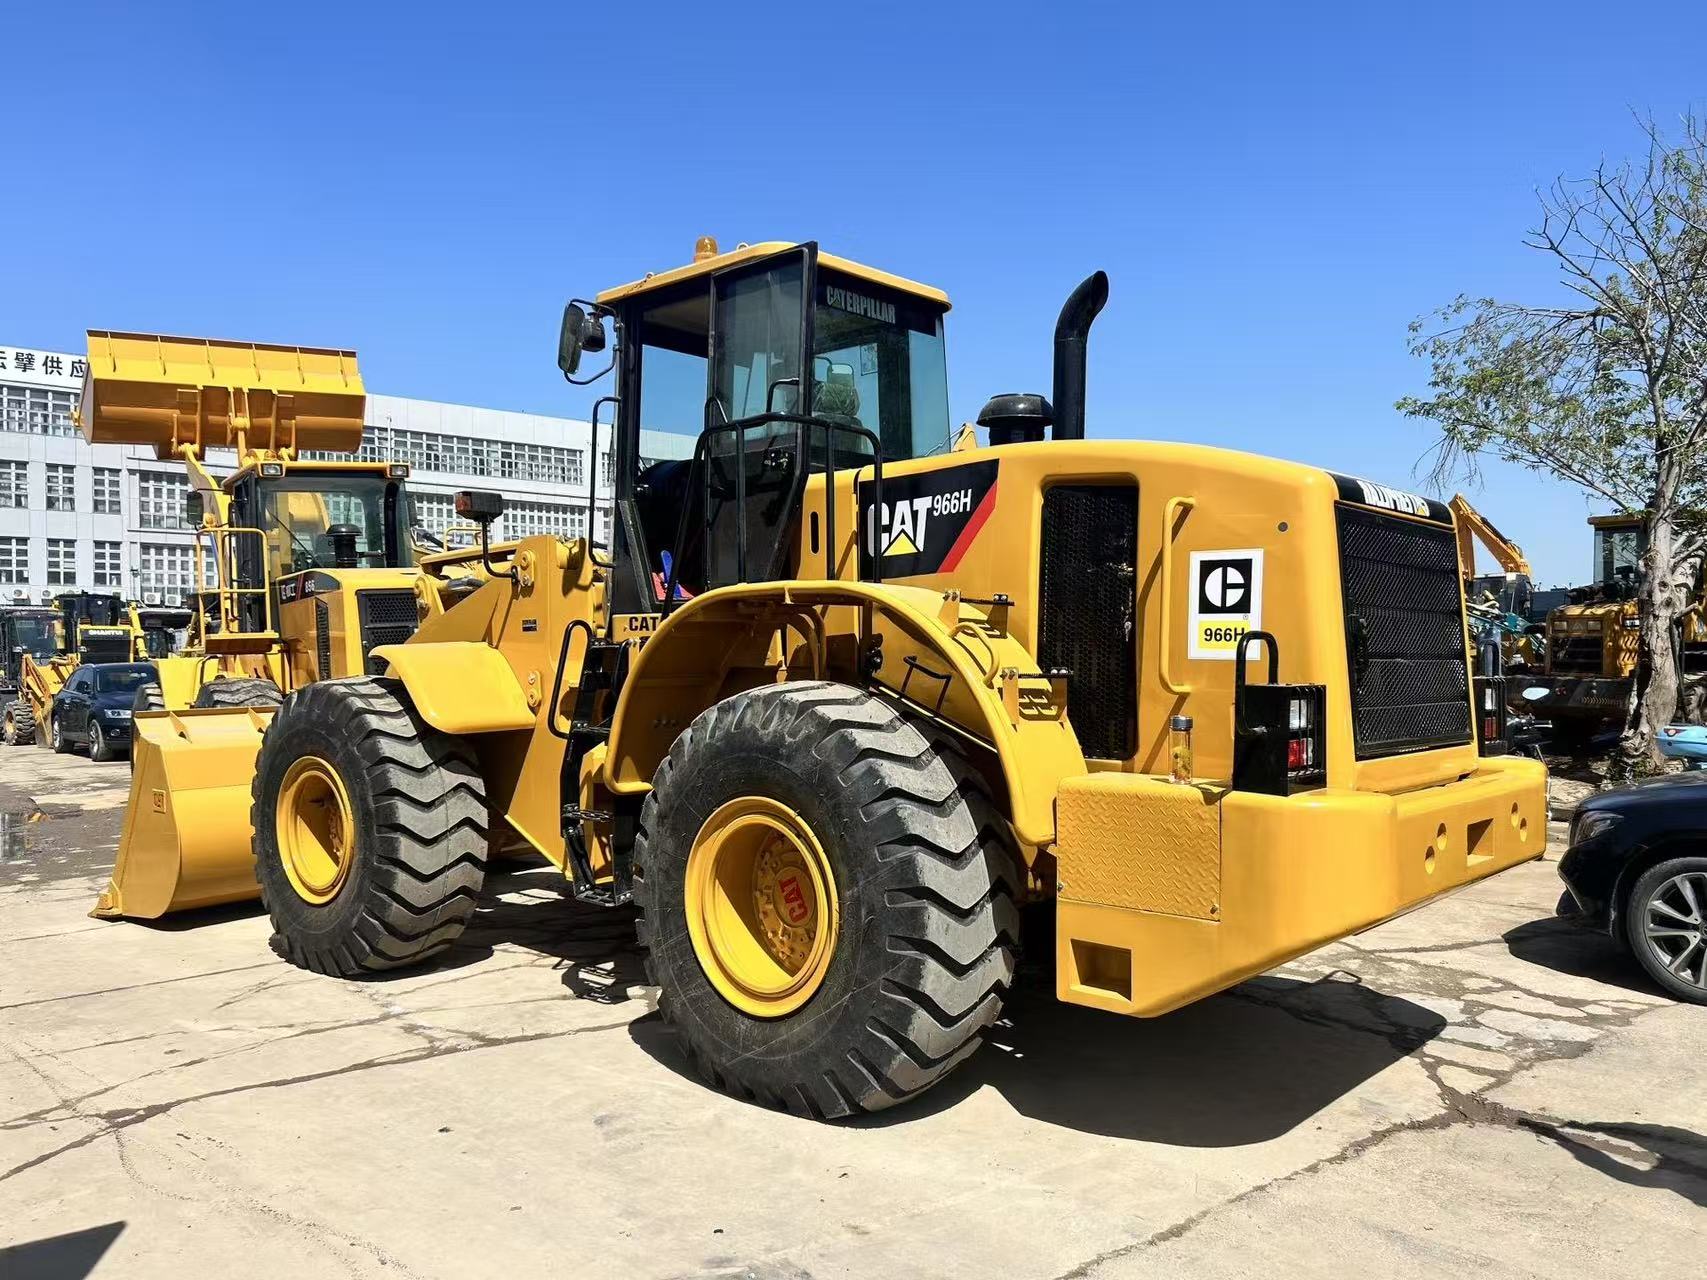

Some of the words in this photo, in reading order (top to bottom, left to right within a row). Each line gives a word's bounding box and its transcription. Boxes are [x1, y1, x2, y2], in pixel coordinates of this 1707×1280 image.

[826, 285, 896, 324] CATERPILLAR
[867, 496, 933, 558] CAT
[933, 488, 972, 517] 966H
[629, 616, 659, 631] CAT
[1204, 627, 1246, 642] 966H
[778, 876, 808, 923] CAT
